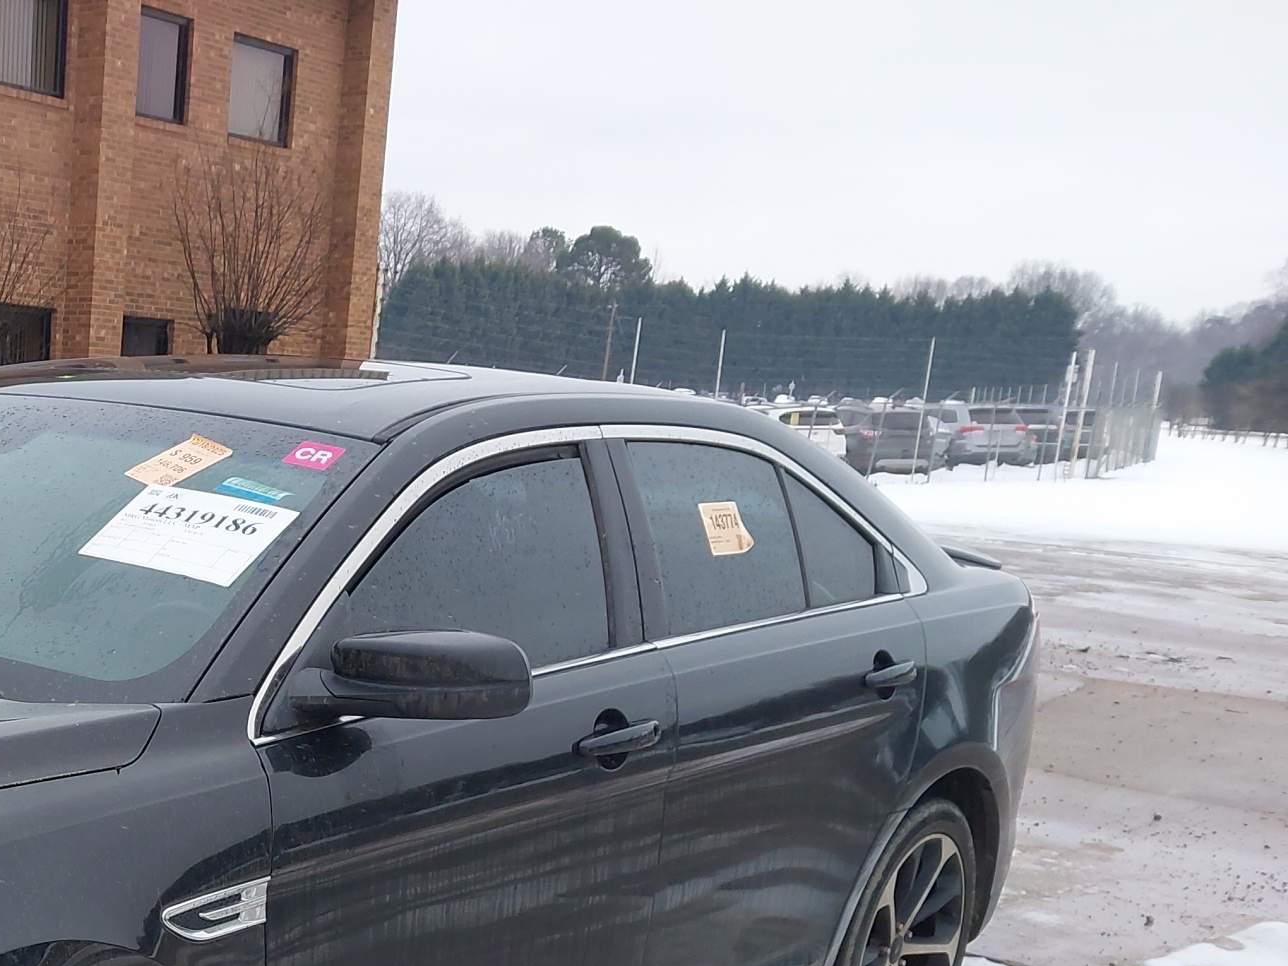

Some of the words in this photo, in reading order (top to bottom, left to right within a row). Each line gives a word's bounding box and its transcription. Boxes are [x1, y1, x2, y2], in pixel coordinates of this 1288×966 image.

[295, 447, 333, 464] CR
[139, 502, 264, 536] 44319186
[710, 513, 740, 530] 143774
